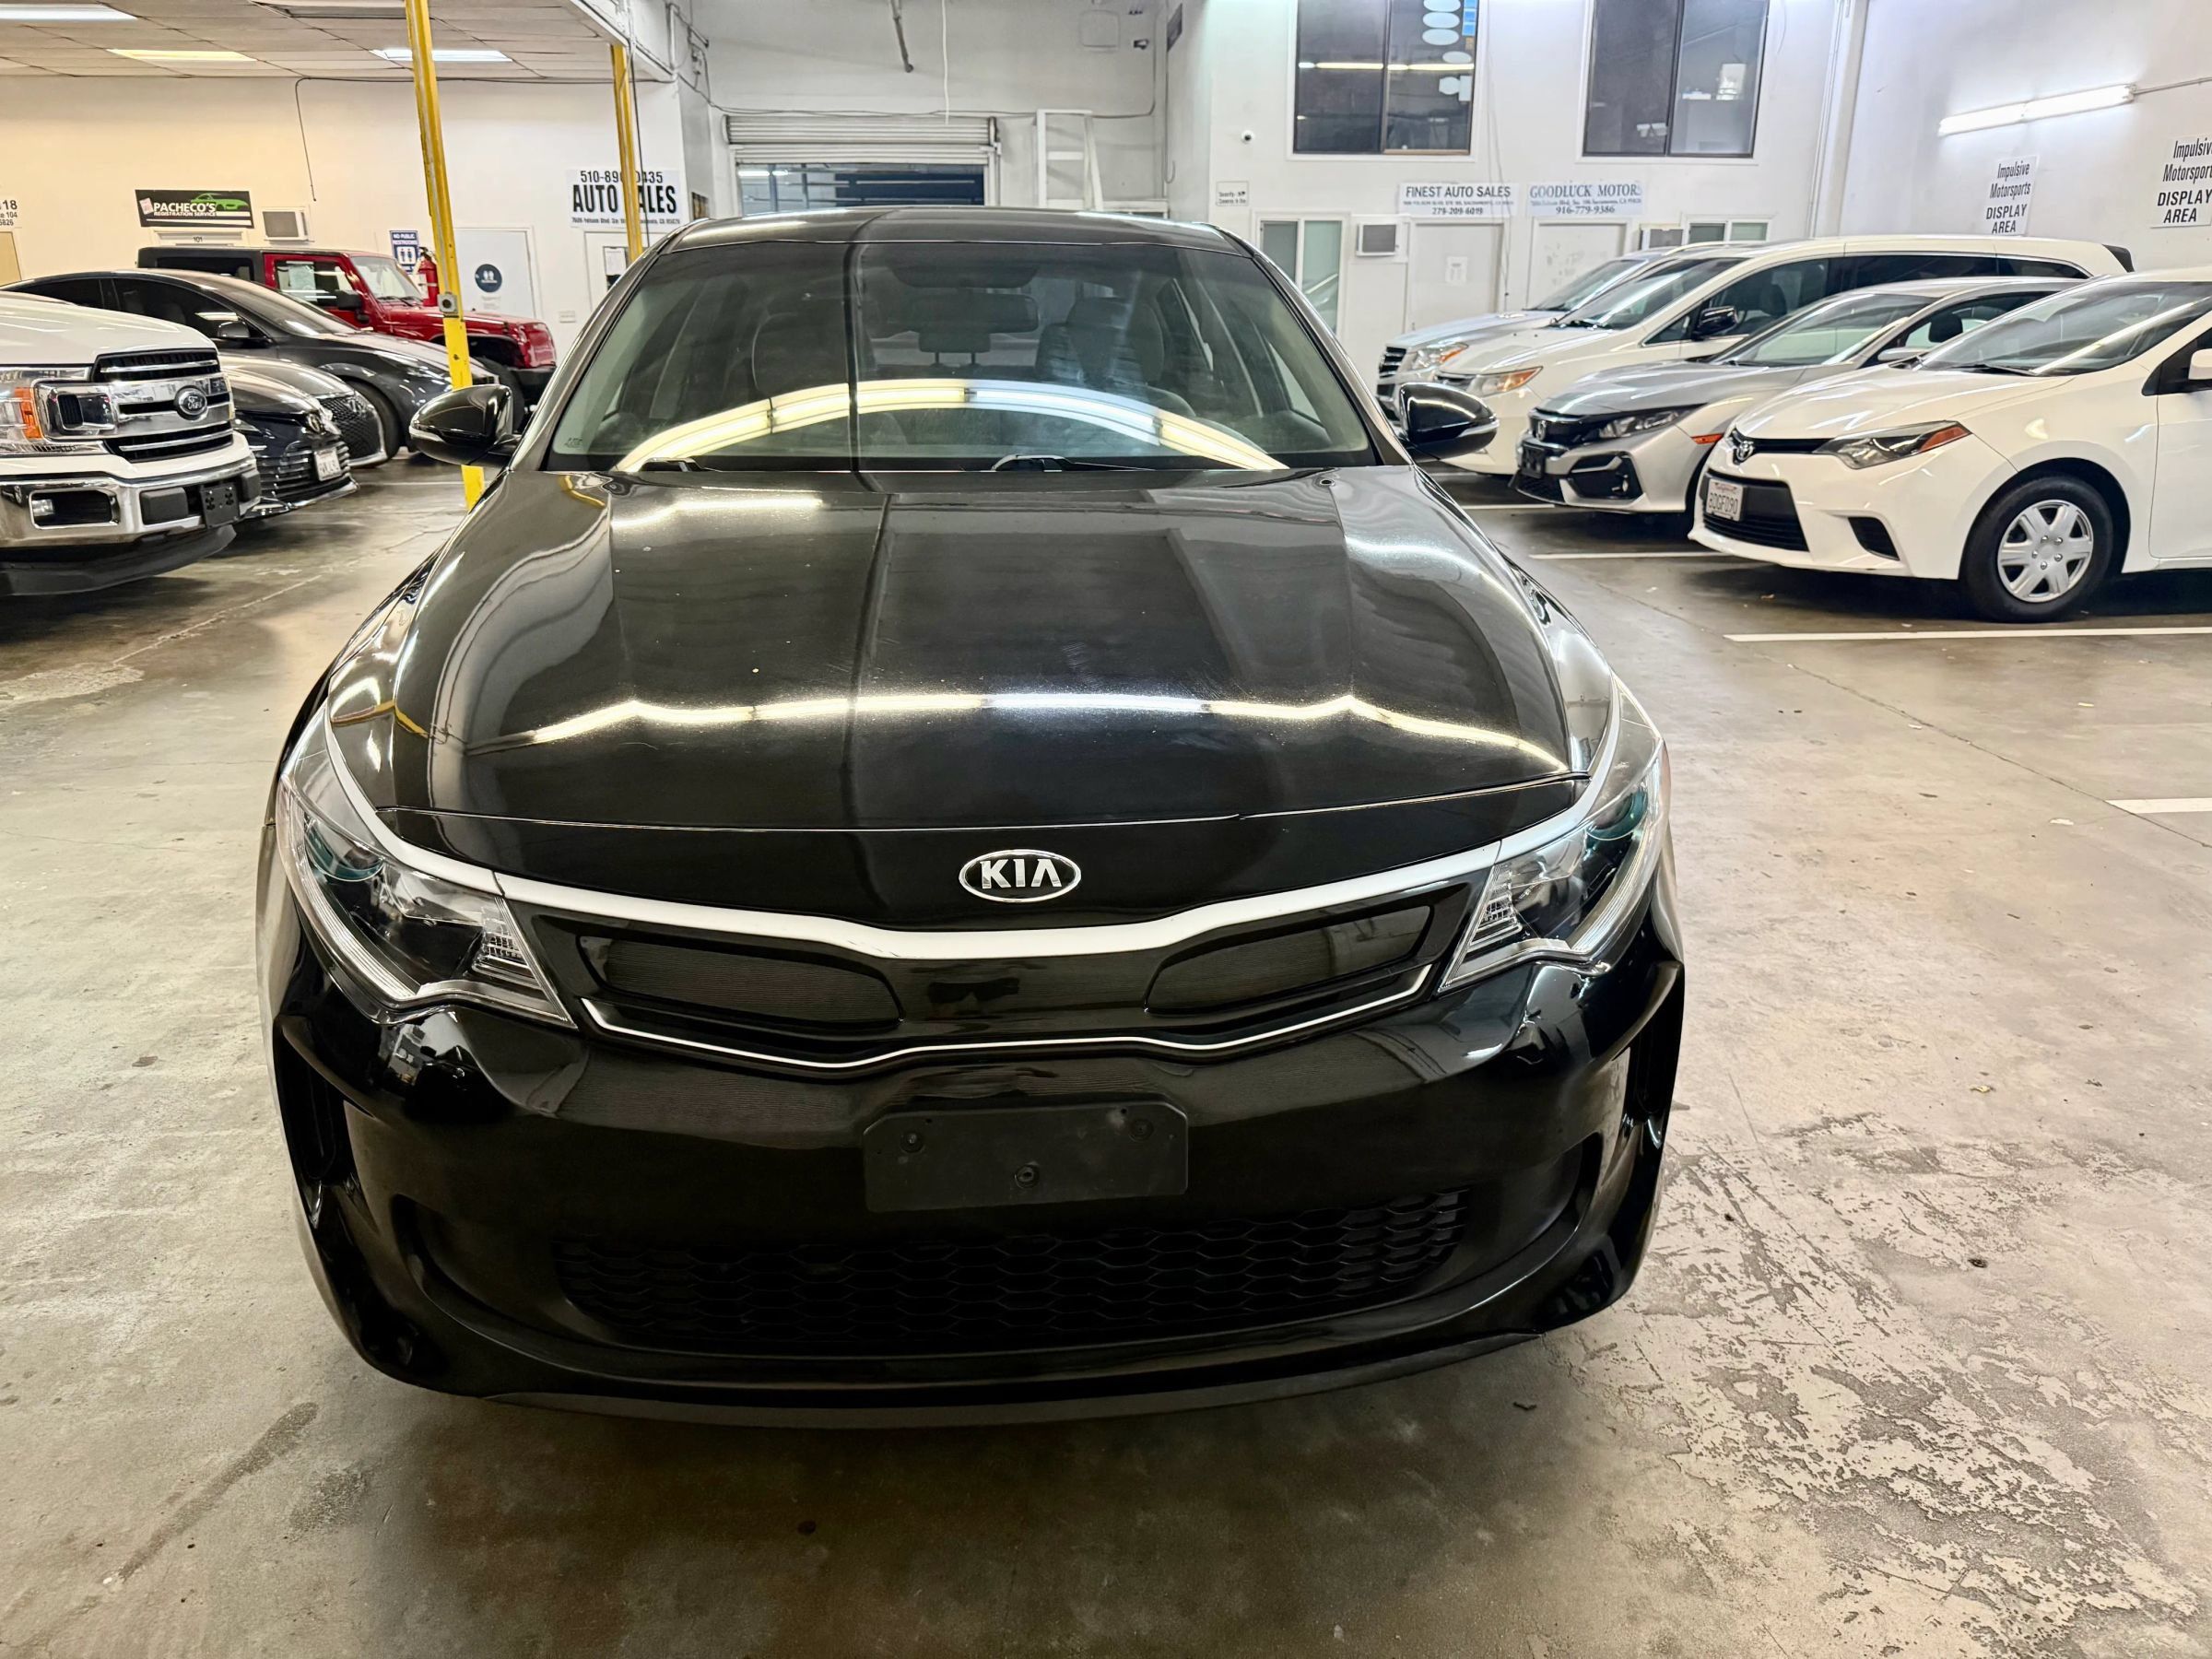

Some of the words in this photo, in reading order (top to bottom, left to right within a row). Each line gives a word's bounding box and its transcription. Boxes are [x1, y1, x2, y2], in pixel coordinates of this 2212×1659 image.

[2173, 137, 2212, 162] Impulsiv
[1997, 159, 2030, 182] Impulsive
[2162, 164, 2212, 184] Motorsport
[572, 184, 618, 213] AUTO
[638, 184, 677, 214] ALES
[1406, 186, 1441, 197] FINEST
[1444, 186, 1474, 197] AUTO
[1477, 185, 1512, 197] SALES
[1530, 184, 1593, 199] GOODLUCK
[1990, 182, 2031, 200] Motorsports
[2157, 188, 2212, 206] DISPLAY
[153, 202, 217, 213] PACHECO'S
[1556, 206, 1616, 215] 916-779-9386
[1986, 204, 2028, 220] DISPLAY
[2163, 207, 2197, 224] AREA
[1992, 220, 2017, 234] AREA
[980, 858, 1063, 889] KIA
